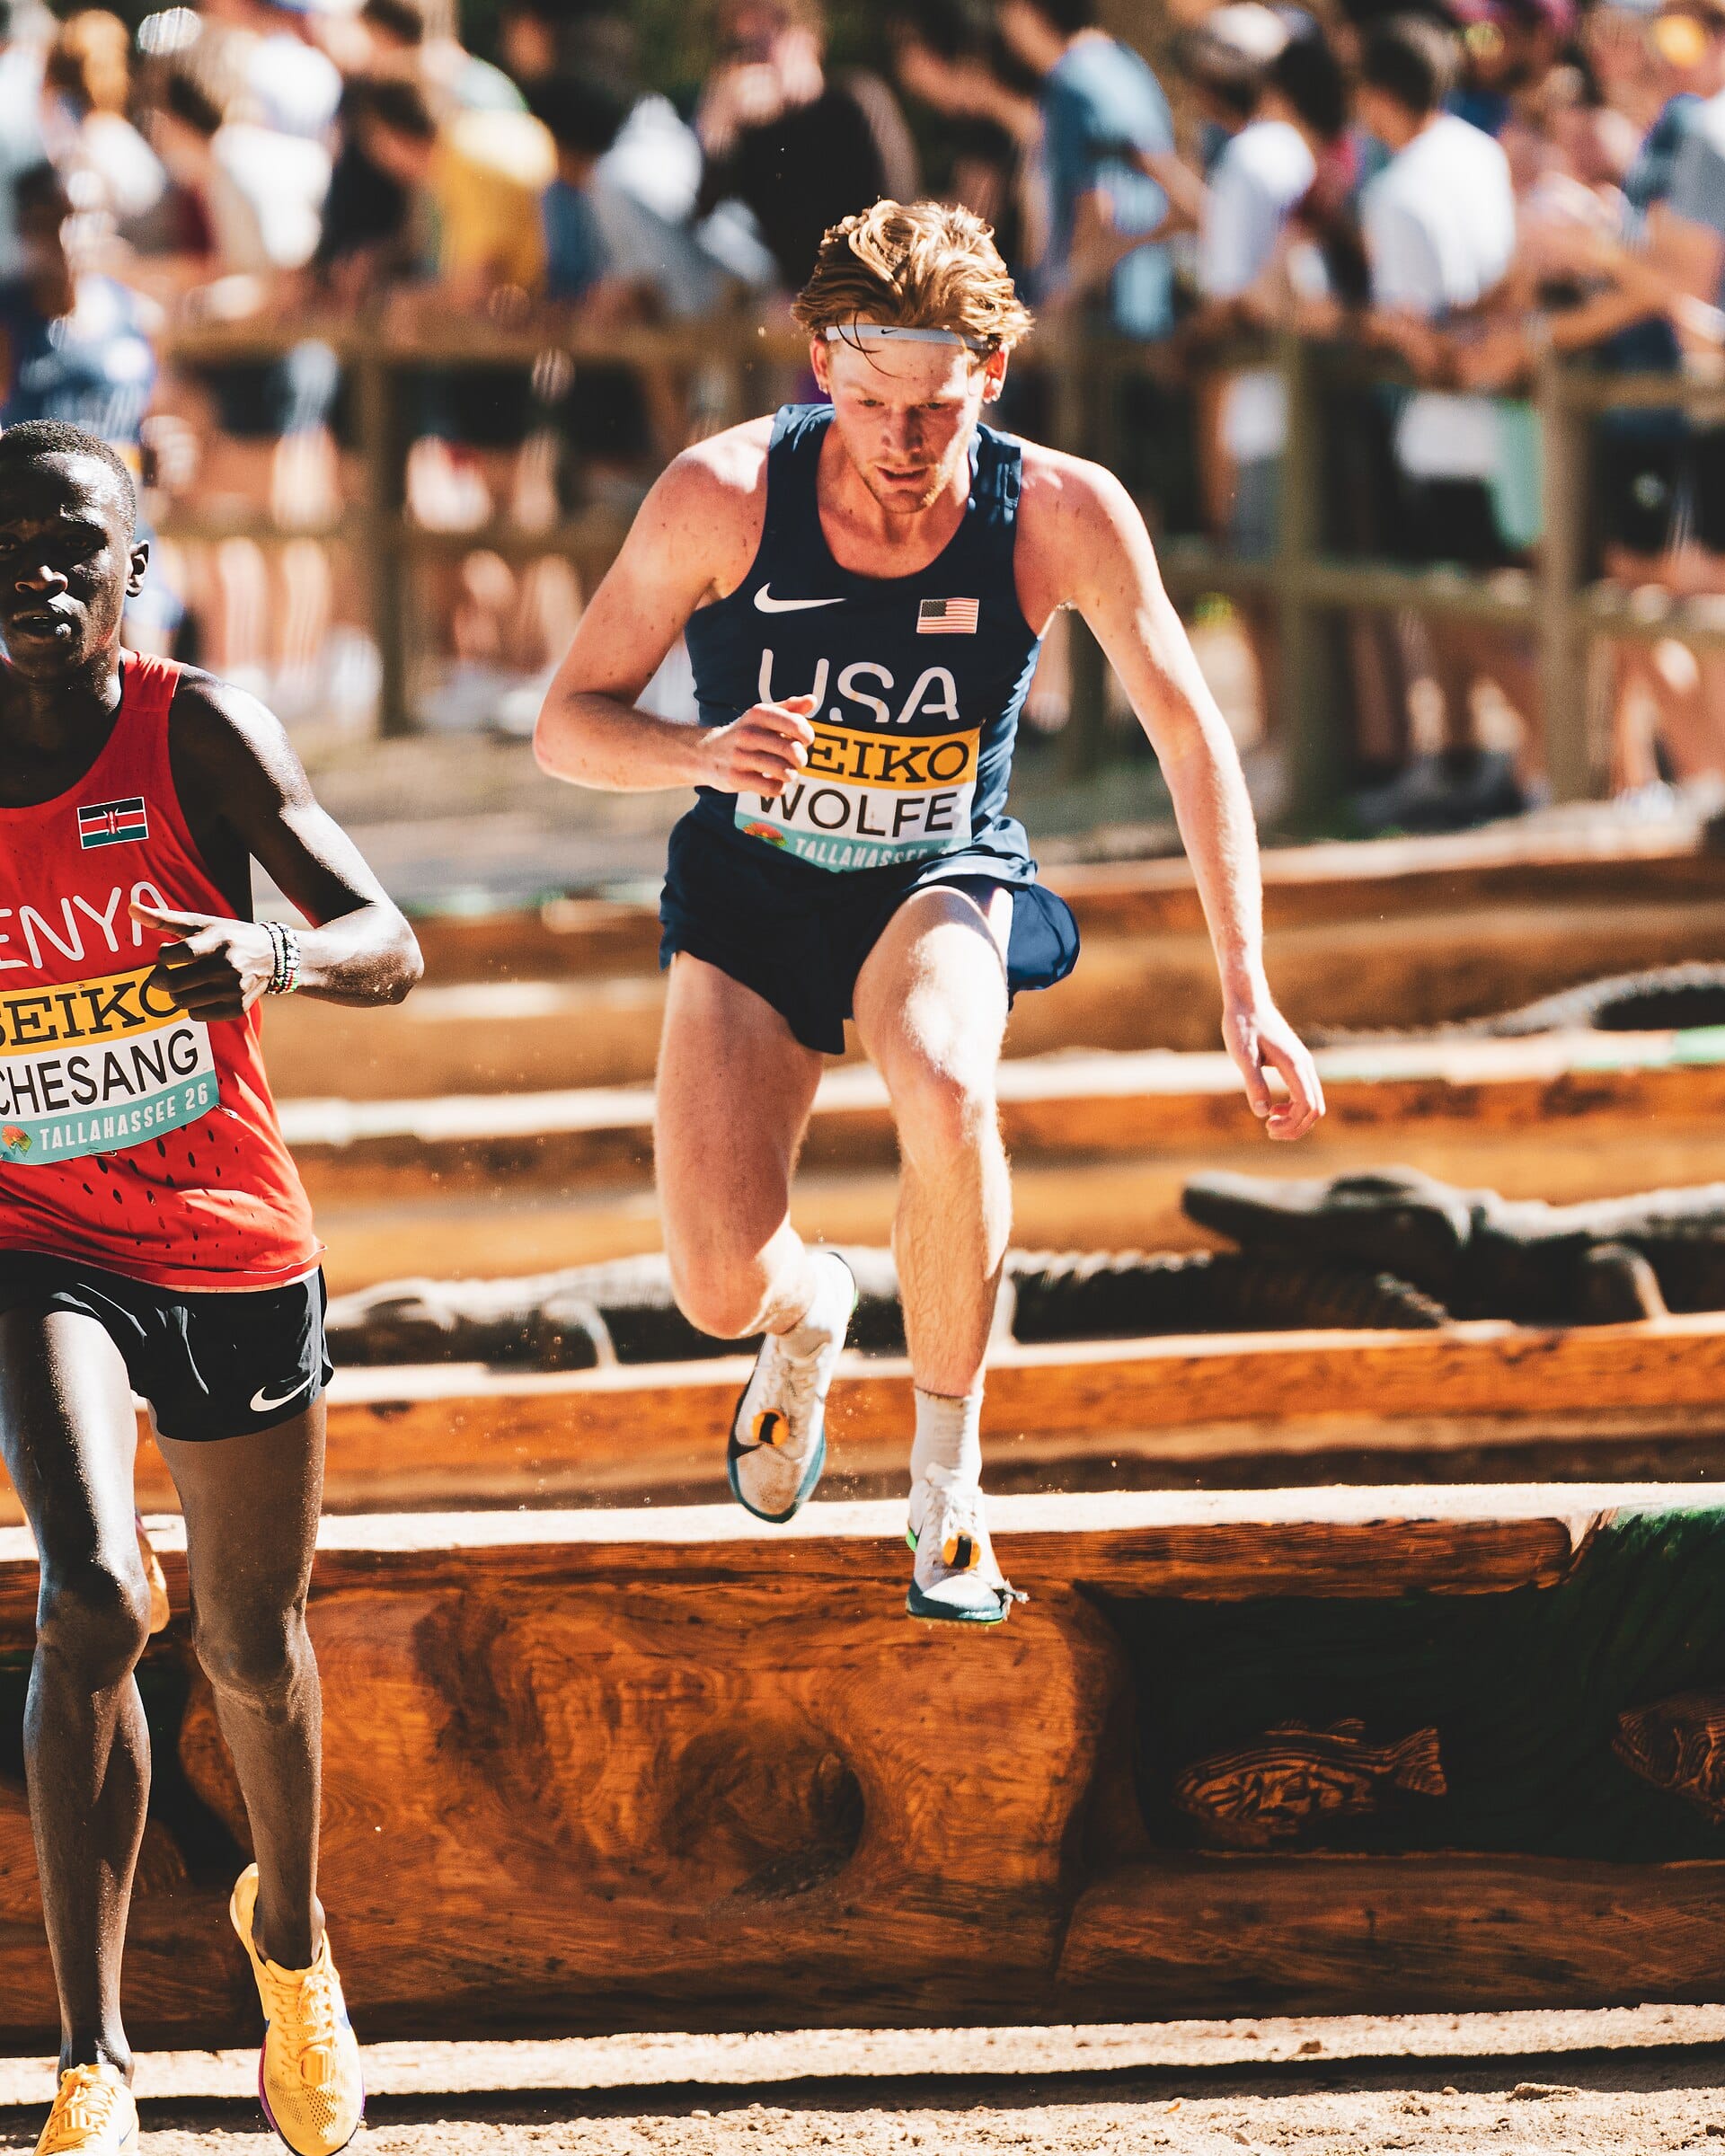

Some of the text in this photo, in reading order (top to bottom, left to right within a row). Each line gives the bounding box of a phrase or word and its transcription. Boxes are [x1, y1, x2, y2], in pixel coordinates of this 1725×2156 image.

[758, 649, 960, 723] USA
[805, 731, 969, 783] EIKO
[0, 881, 169, 969] ENYA
[0, 976, 181, 1047] EIKO
[40, 1082, 208, 1150] TALLAHASSEE 26
